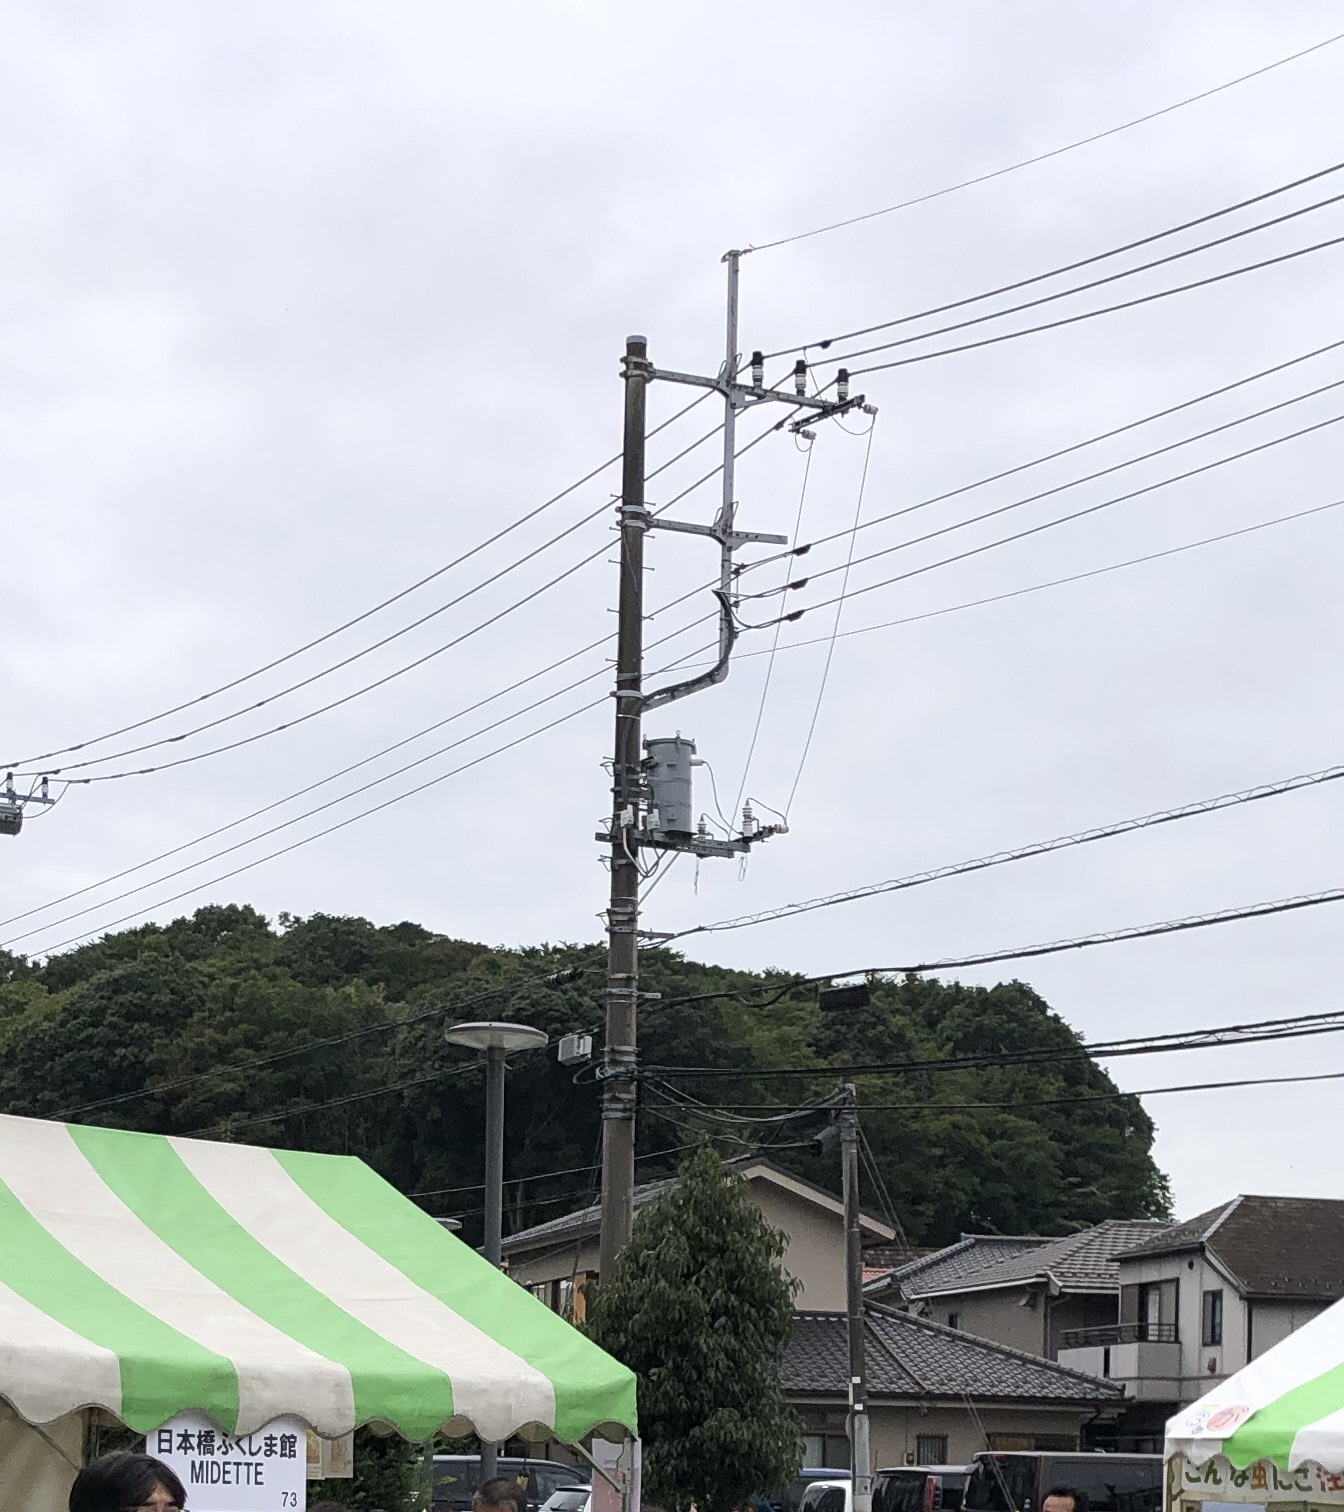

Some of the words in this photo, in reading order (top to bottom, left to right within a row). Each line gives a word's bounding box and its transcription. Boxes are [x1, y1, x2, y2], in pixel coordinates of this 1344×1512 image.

[158, 1429, 298, 1459] 日本橋ふくしま館
[190, 1460, 264, 1485] MIDETTE
[281, 1492, 298, 1507] 73
